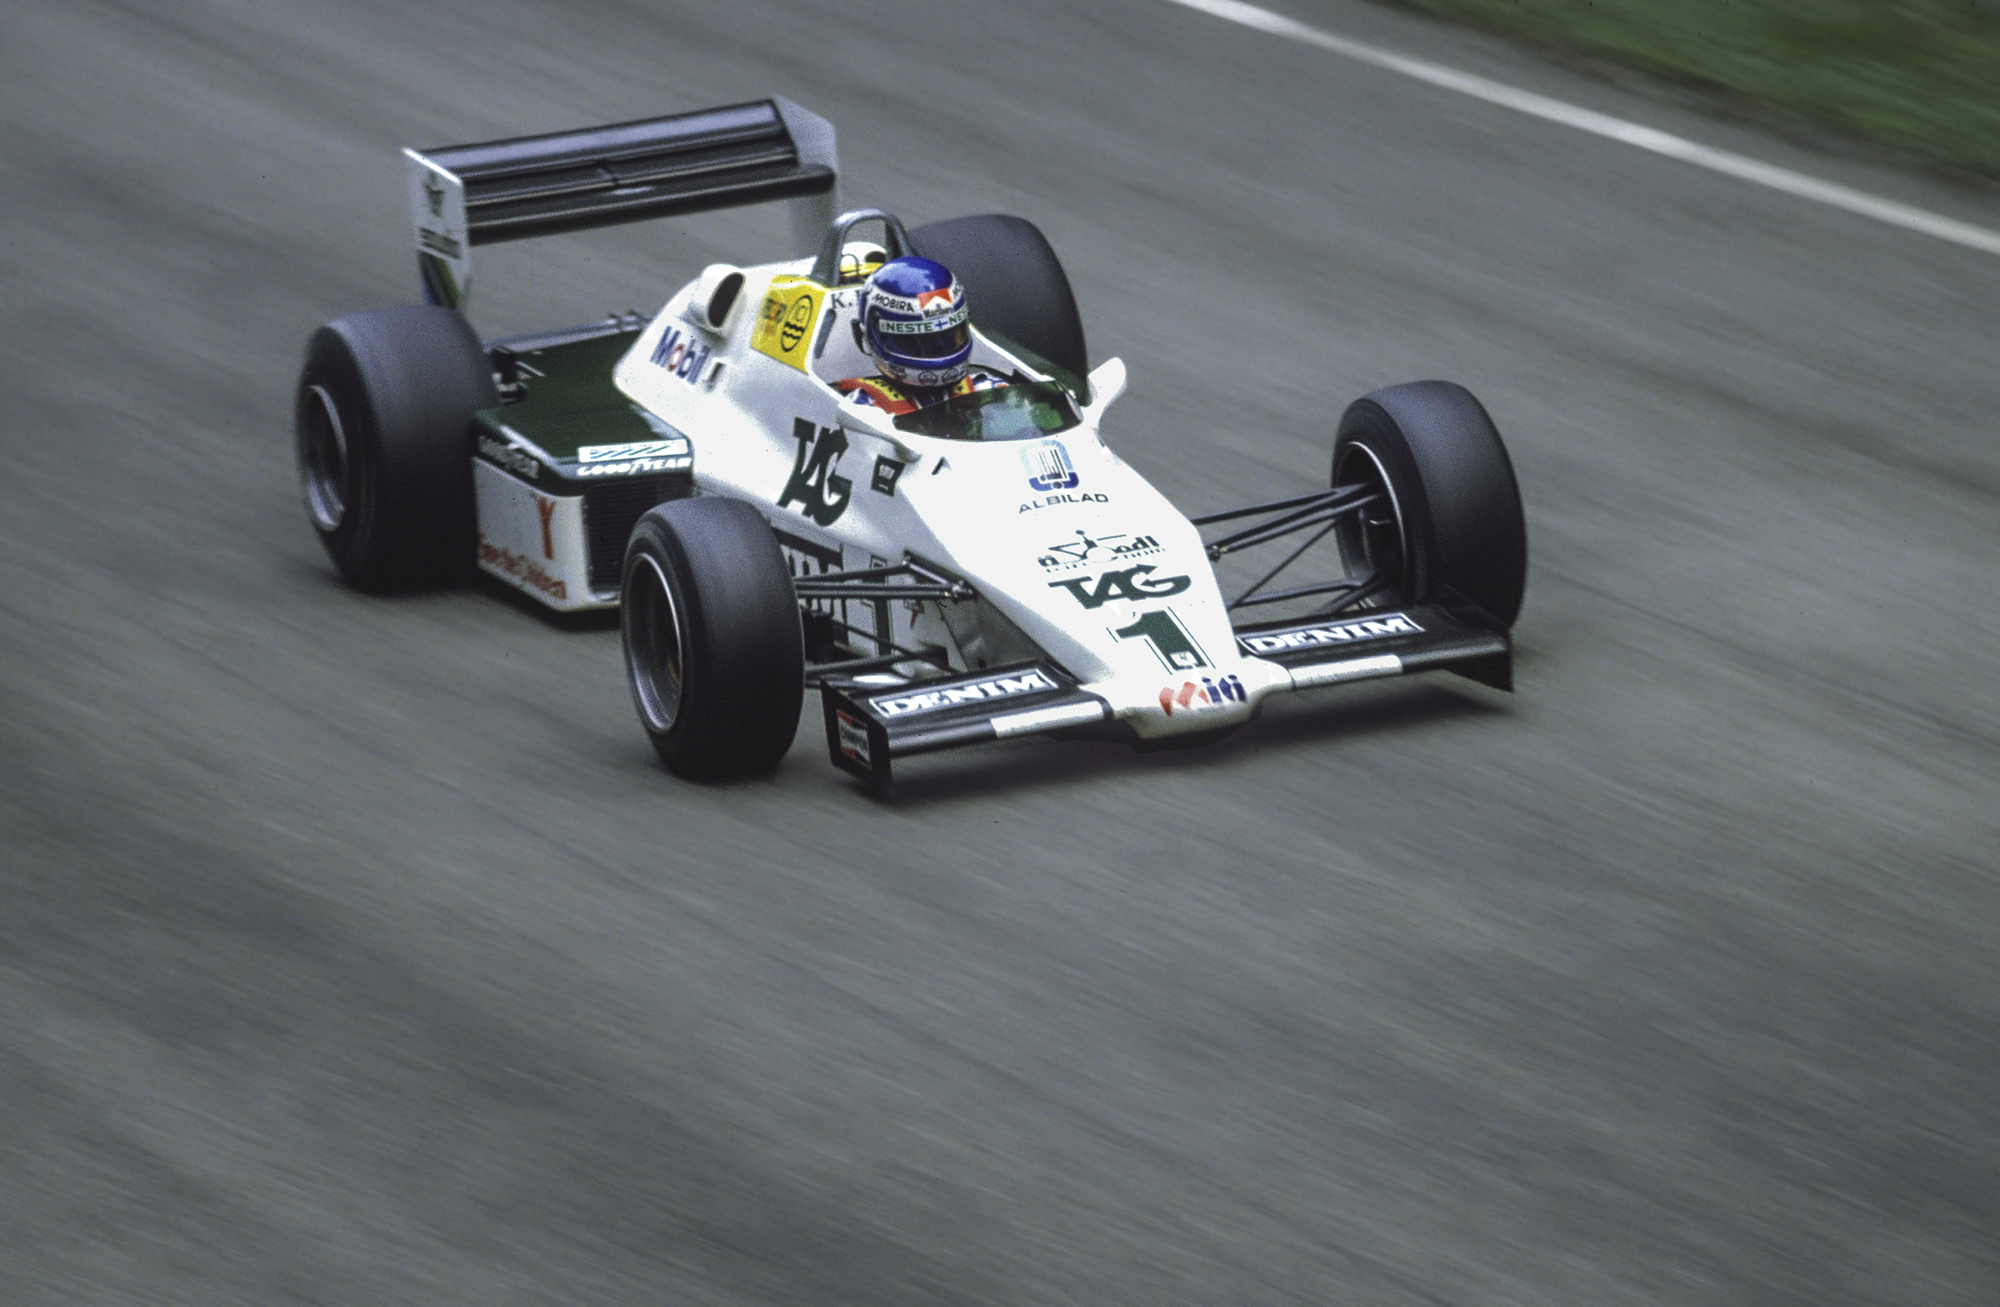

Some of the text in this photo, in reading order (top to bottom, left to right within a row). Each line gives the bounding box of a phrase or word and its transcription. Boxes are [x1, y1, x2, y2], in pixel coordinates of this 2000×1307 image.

[872, 294, 914, 312] MOBIRA
[886, 321, 933, 333] NESTE
[649, 325, 711, 385] Mobil
[577, 457, 692, 477] GOODYEAR
[777, 416, 852, 527] TAG
[1019, 493, 1109, 514] ALBILAD
[1047, 563, 1192, 610] TAG
[1114, 608, 1208, 671] 1
[1246, 617, 1415, 651] DENIM
[877, 673, 1047, 716] DENIM
